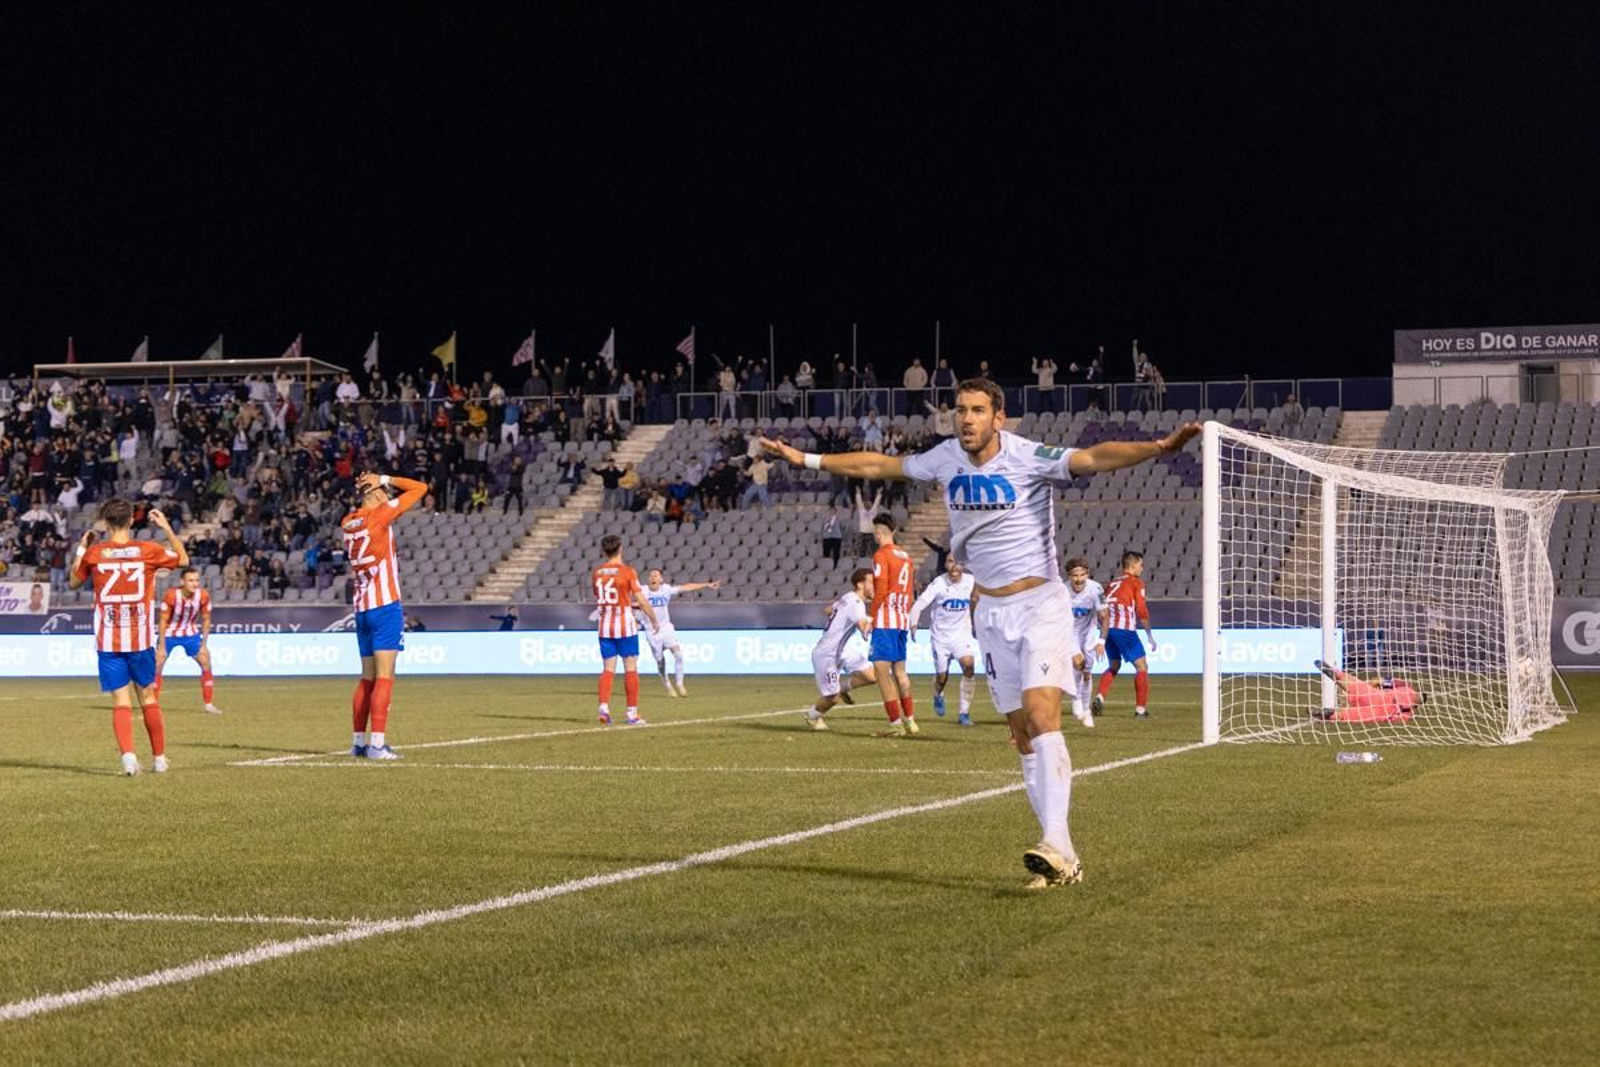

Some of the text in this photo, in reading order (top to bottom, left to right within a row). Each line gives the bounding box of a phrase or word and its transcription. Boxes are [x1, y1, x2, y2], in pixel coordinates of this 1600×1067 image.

[1422, 338, 1452, 351] HOY
[1456, 337, 1475, 350] ES
[1521, 335, 1543, 348] DE
[1545, 334, 1598, 348] GANAR
[97, 561, 146, 603] 23
[897, 560, 910, 592] 4
[594, 577, 619, 605] 16
[1103, 580, 1123, 602] 2
[255, 639, 340, 667] Blaveo
[735, 636, 812, 667] Blave
[1219, 637, 1298, 664] laveo
[826, 671, 838, 684] 19
[985, 652, 997, 680] 4
